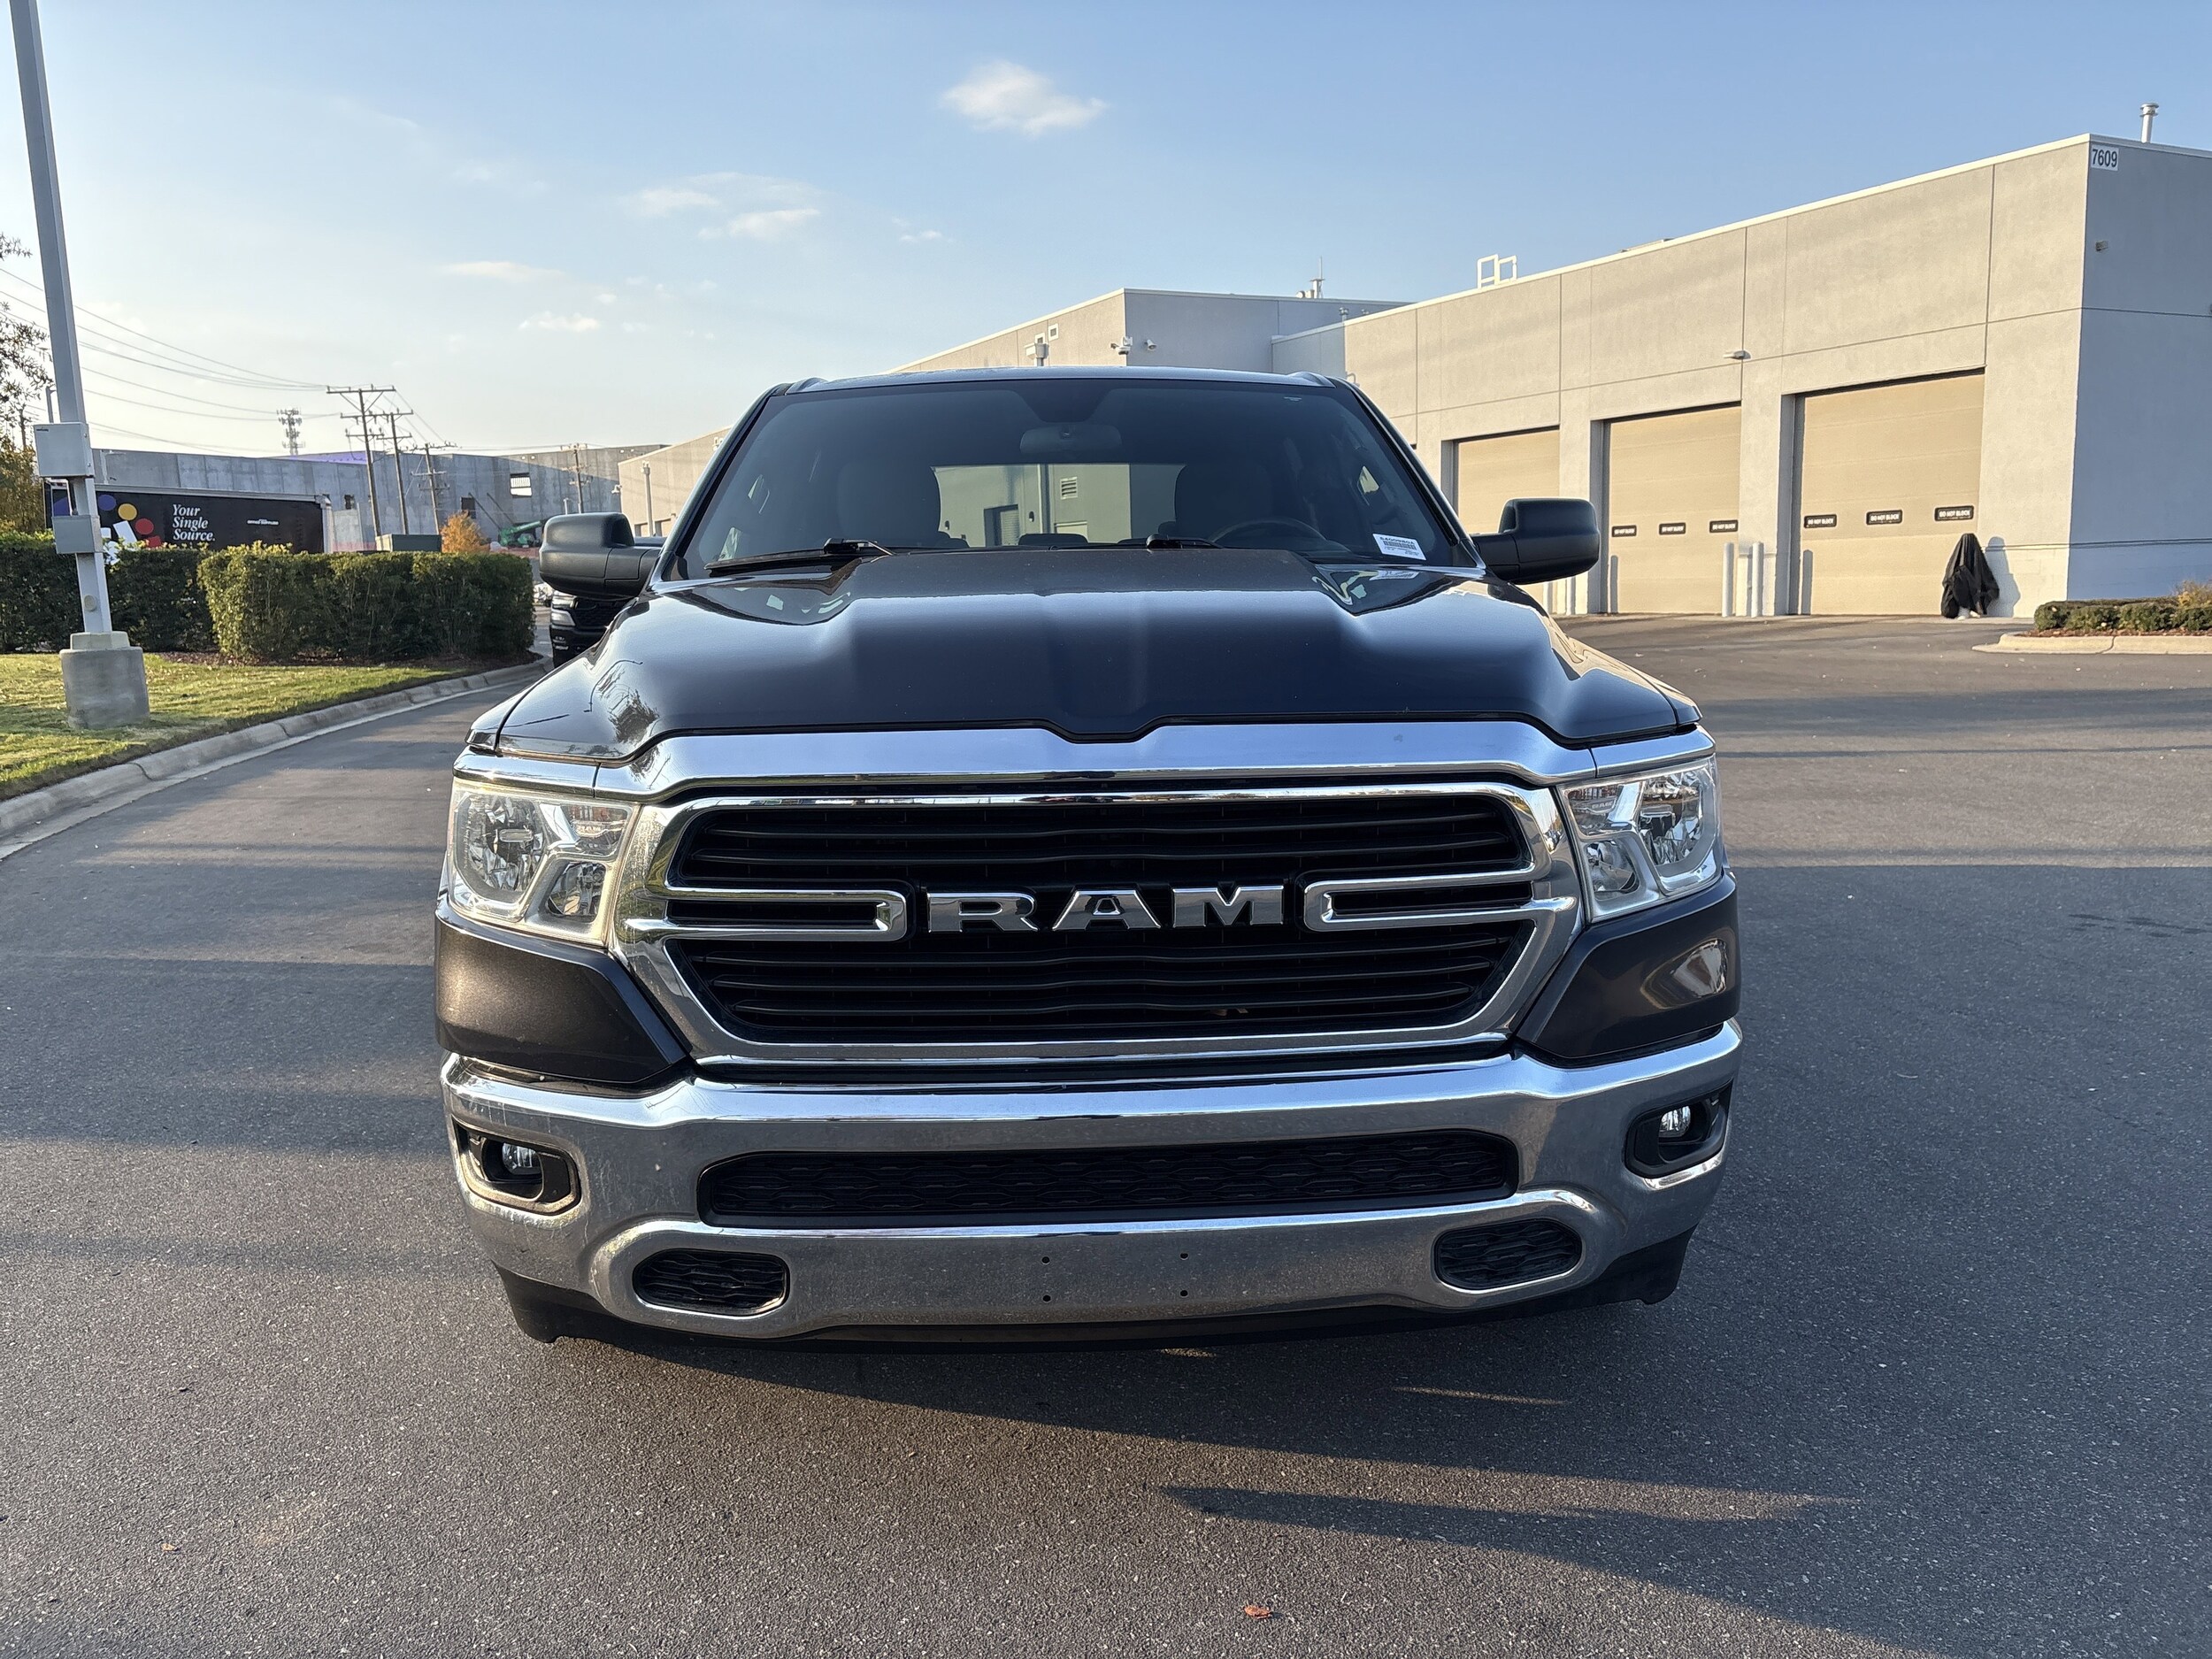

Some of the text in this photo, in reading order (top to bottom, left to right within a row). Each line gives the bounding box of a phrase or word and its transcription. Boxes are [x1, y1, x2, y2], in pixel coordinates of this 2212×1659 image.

[2093, 149, 2117, 167] 7609
[173, 504, 201, 516] Your
[173, 517, 209, 532] Single
[173, 528, 216, 541] Source.
[926, 885, 1285, 933] RAM
